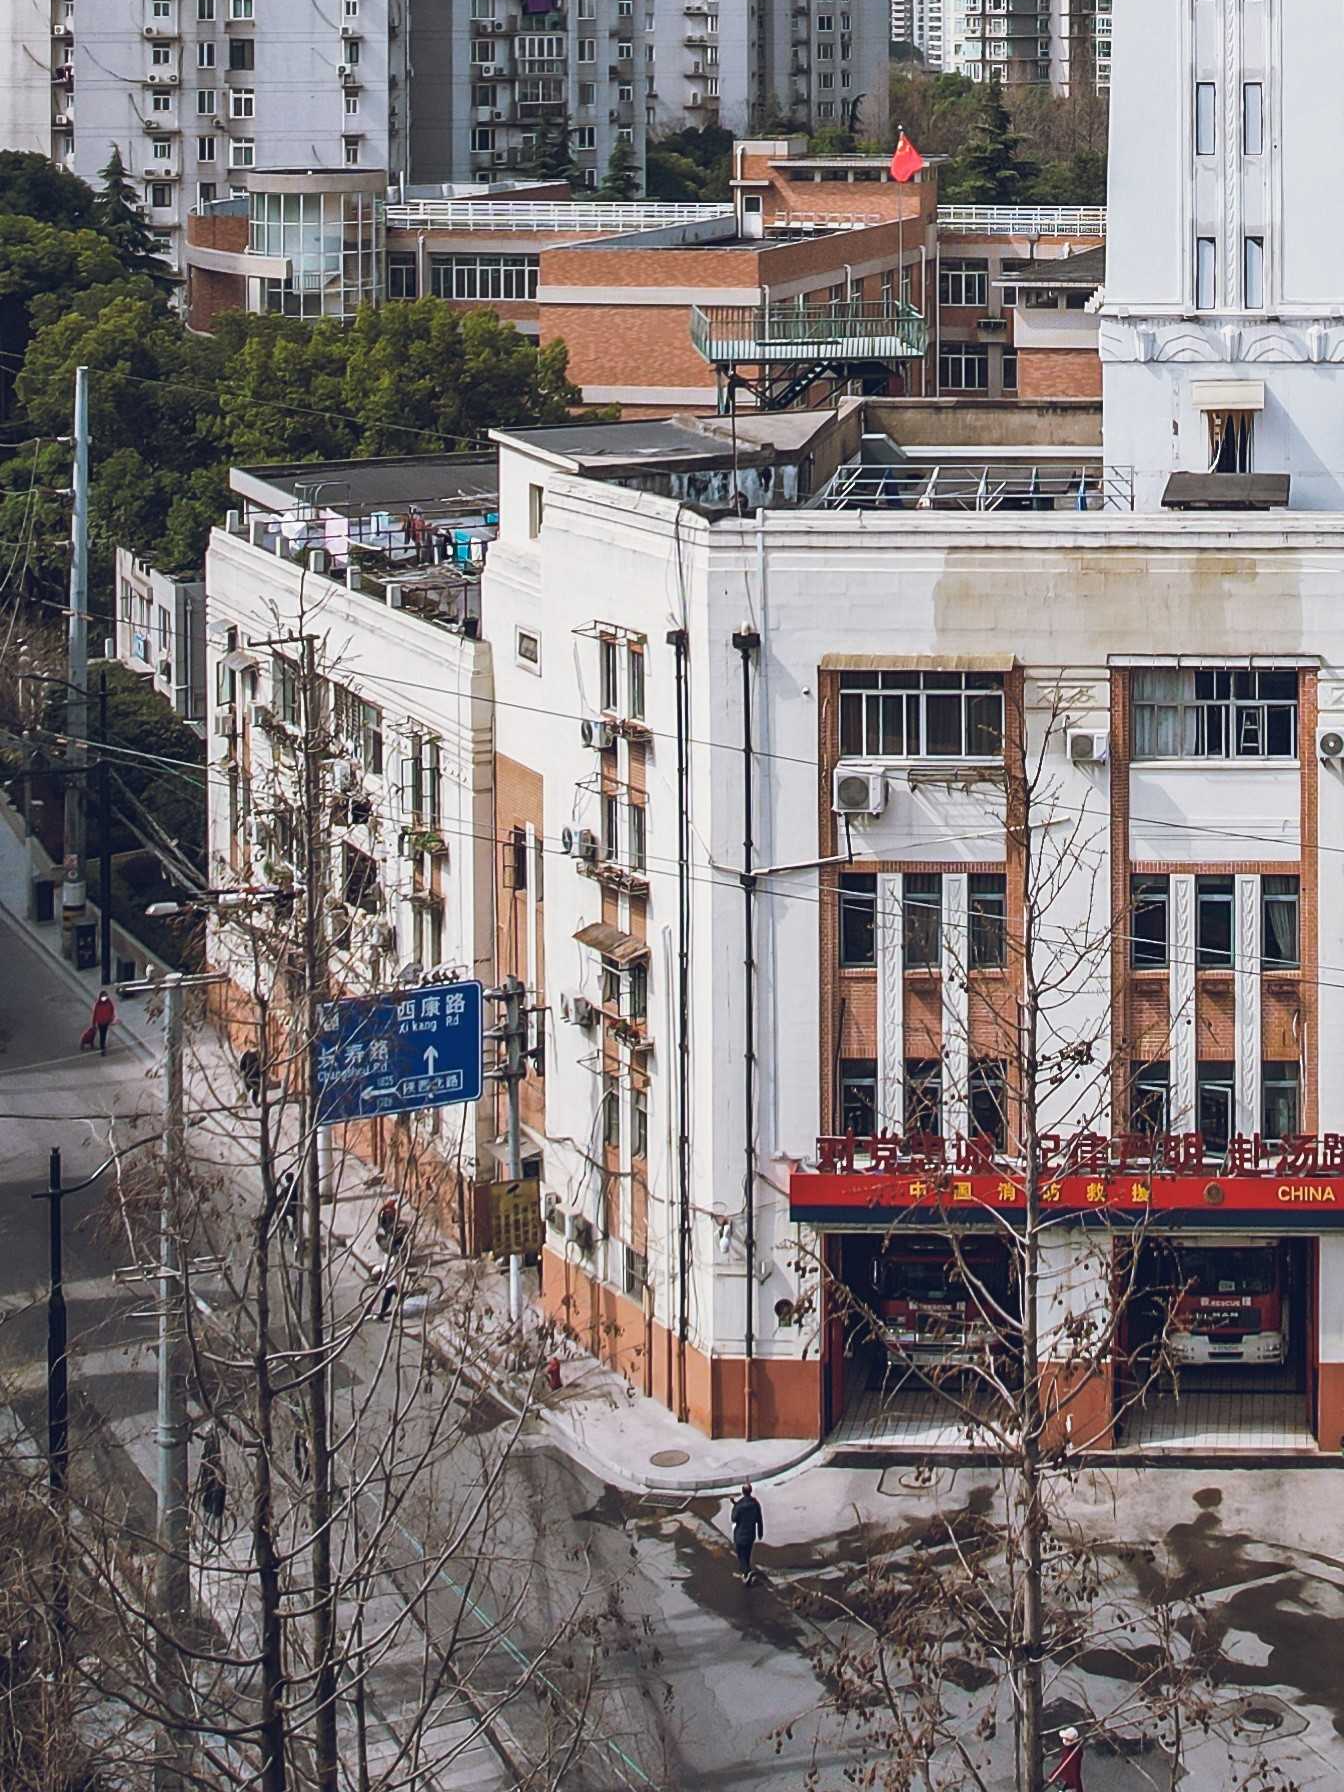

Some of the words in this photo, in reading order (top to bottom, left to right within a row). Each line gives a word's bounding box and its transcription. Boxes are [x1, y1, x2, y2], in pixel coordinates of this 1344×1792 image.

[397, 992, 466, 1021] 西康路
[909, 1181, 1150, 1203] 中国消防救援
[1277, 1185, 1336, 1202] CHINA
